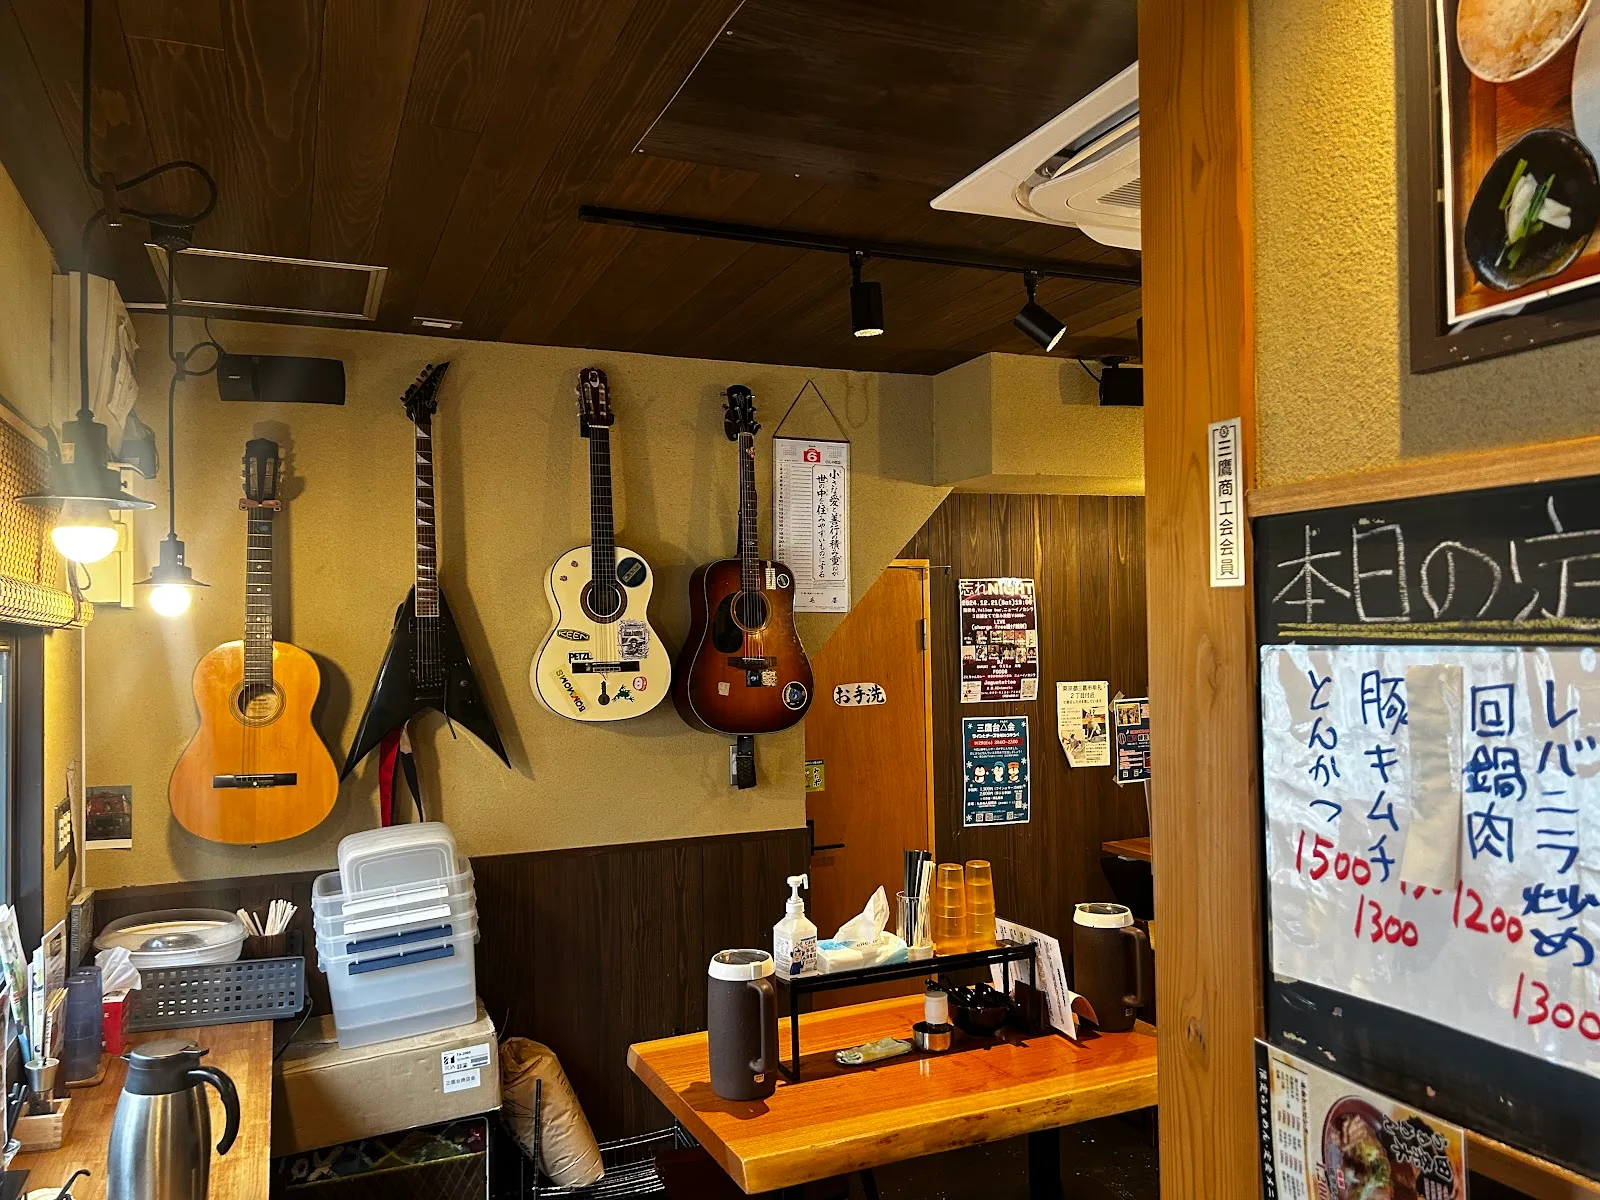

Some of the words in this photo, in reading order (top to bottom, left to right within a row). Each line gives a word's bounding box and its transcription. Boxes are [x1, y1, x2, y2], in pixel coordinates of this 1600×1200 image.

[806, 452, 818, 462] 6
[1217, 439, 1234, 576] 三鷹商工会会員
[558, 630, 590, 641] KEEN
[568, 652, 593, 662] PETZL
[834, 686, 885, 705] お手洗
[1308, 670, 1342, 822] とんかつ
[1463, 683, 1527, 862] 回鍋肉
[1361, 669, 1409, 882] 豚キムチ
[1294, 830, 1371, 886] 1500
[1355, 894, 1419, 947] 1300
[1452, 880, 1524, 944] 1200
